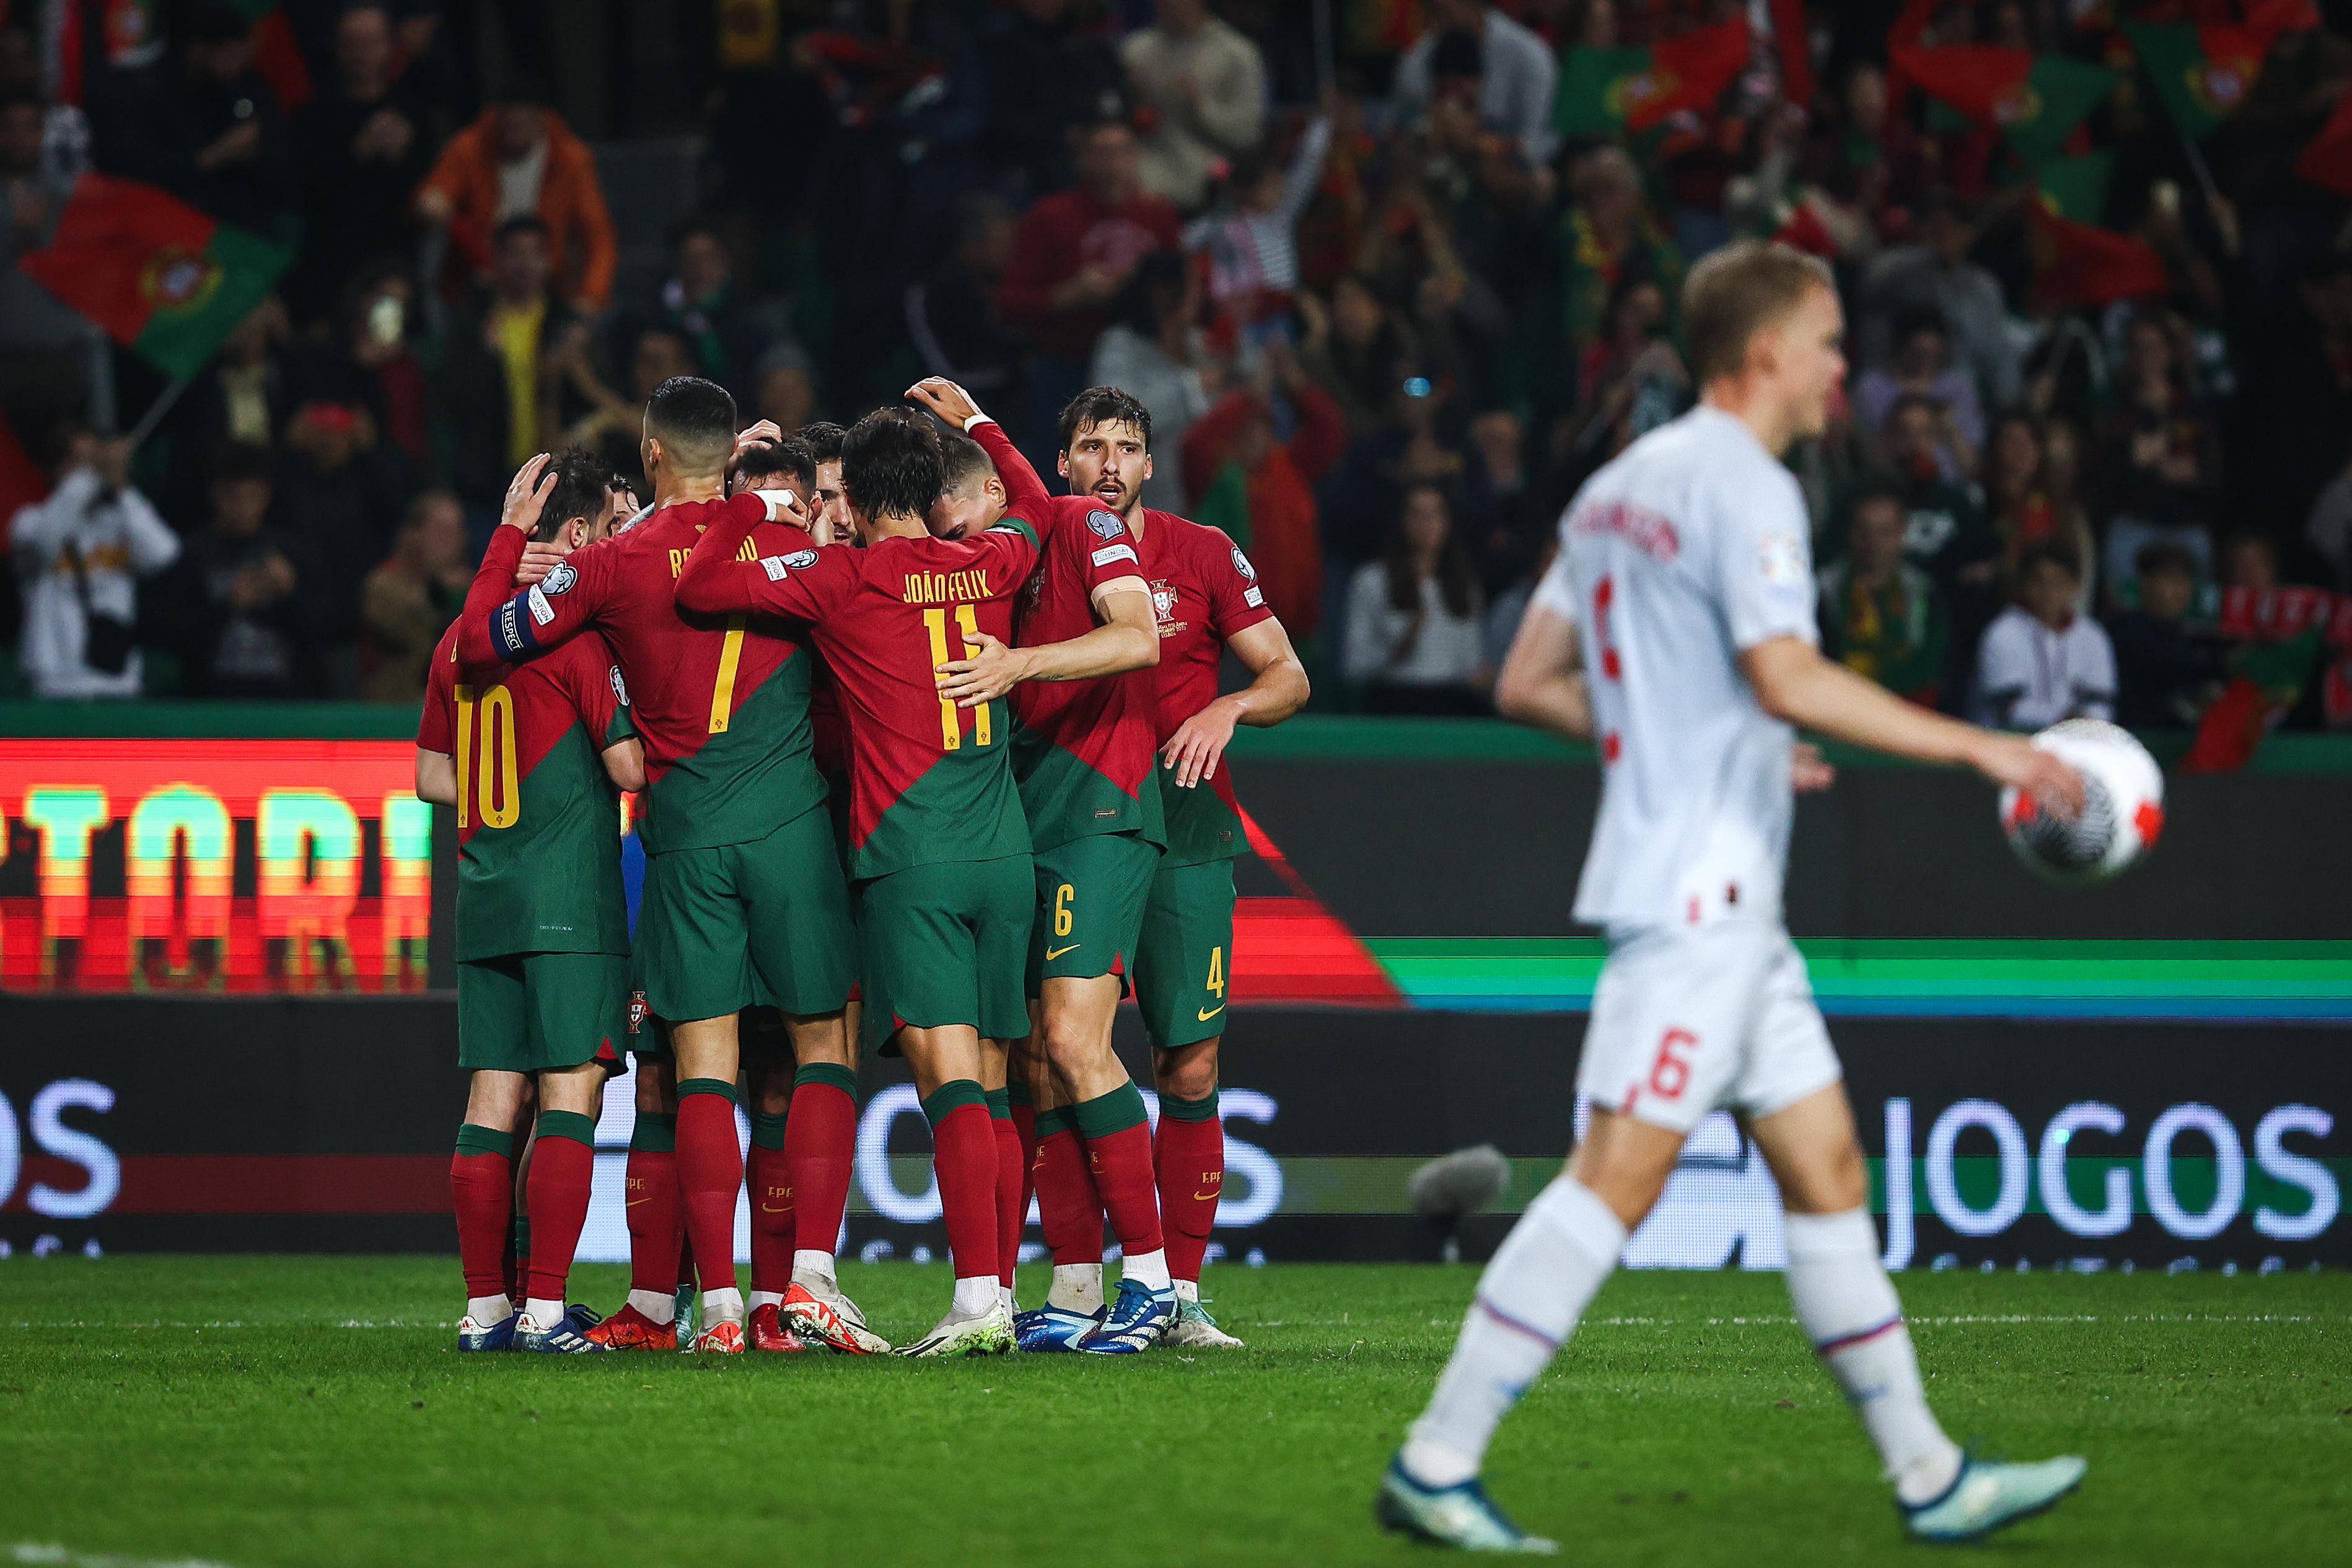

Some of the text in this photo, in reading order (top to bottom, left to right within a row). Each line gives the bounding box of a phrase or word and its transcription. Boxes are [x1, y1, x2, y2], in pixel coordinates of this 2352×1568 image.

[903, 569, 994, 603] JOÃO FELIX
[504, 610, 521, 649] RESPECT
[923, 604, 991, 750] 11
[454, 684, 520, 828] 10
[1055, 883, 1074, 936] 6
[1206, 946, 1224, 999] 4
[1648, 1024, 1700, 1102] 6
[1881, 1097, 2341, 1272] JOGOS
